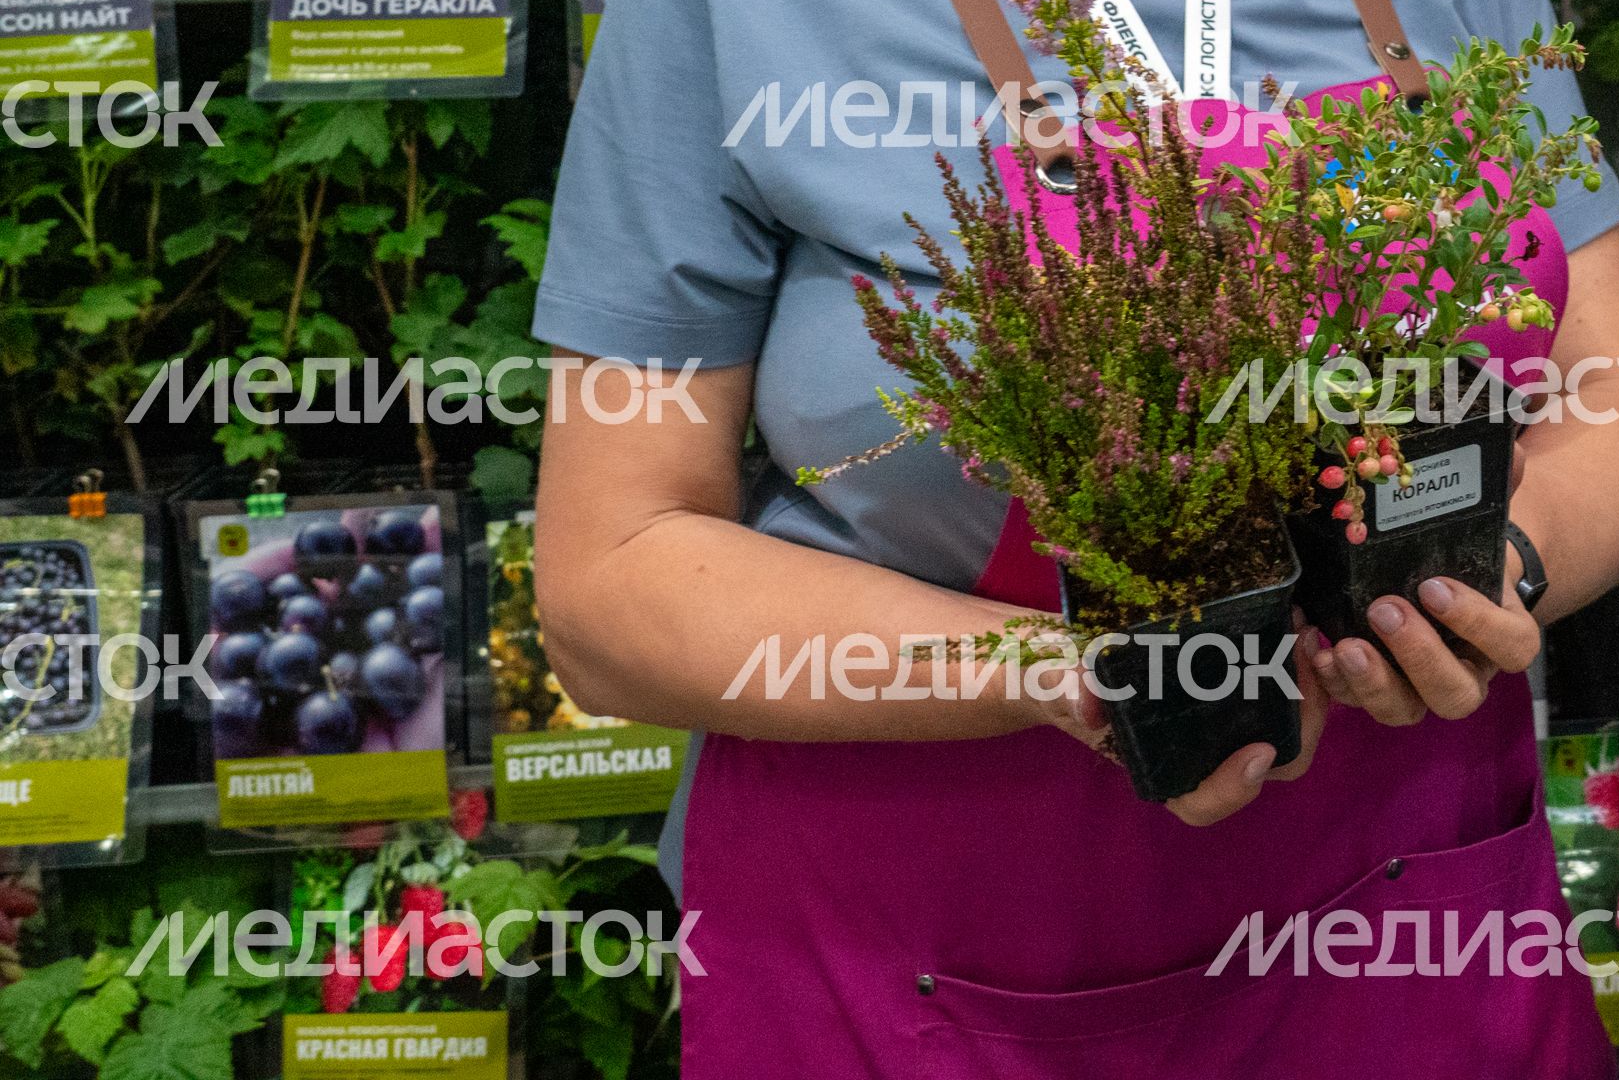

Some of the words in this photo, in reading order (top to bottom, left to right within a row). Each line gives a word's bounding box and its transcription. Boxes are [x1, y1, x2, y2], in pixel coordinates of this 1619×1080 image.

[60, 4, 132, 29] НАЙТ
[1103, 0, 1148, 62] ФЛЕКС
[1414, 458, 1450, 476] усника
[1392, 472, 1460, 503] КОРАЛЛ
[505, 745, 672, 782] ВЕРСАЛЬСКАЯ
[229, 767, 314, 797] ЛЕНТЯЙ
[296, 1037, 389, 1061] КРАСНАЯ
[394, 1036, 489, 1061] ГВАРДИЯ
